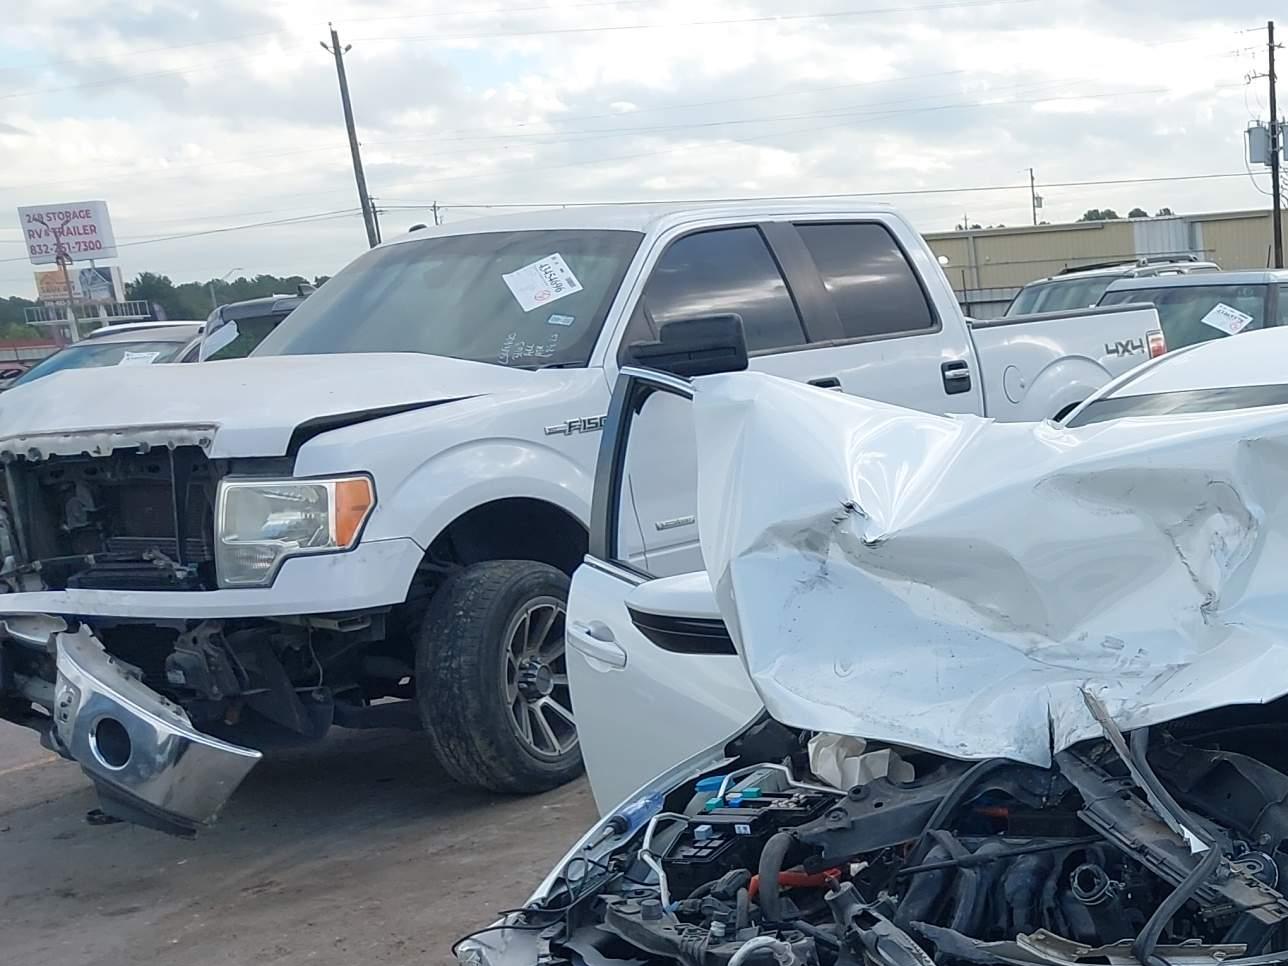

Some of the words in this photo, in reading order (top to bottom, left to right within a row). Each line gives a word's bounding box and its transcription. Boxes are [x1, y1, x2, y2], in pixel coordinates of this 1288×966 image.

[45, 209, 92, 222] STORAGE
[27, 229, 43, 240] RV
[50, 224, 97, 237] TRAILER
